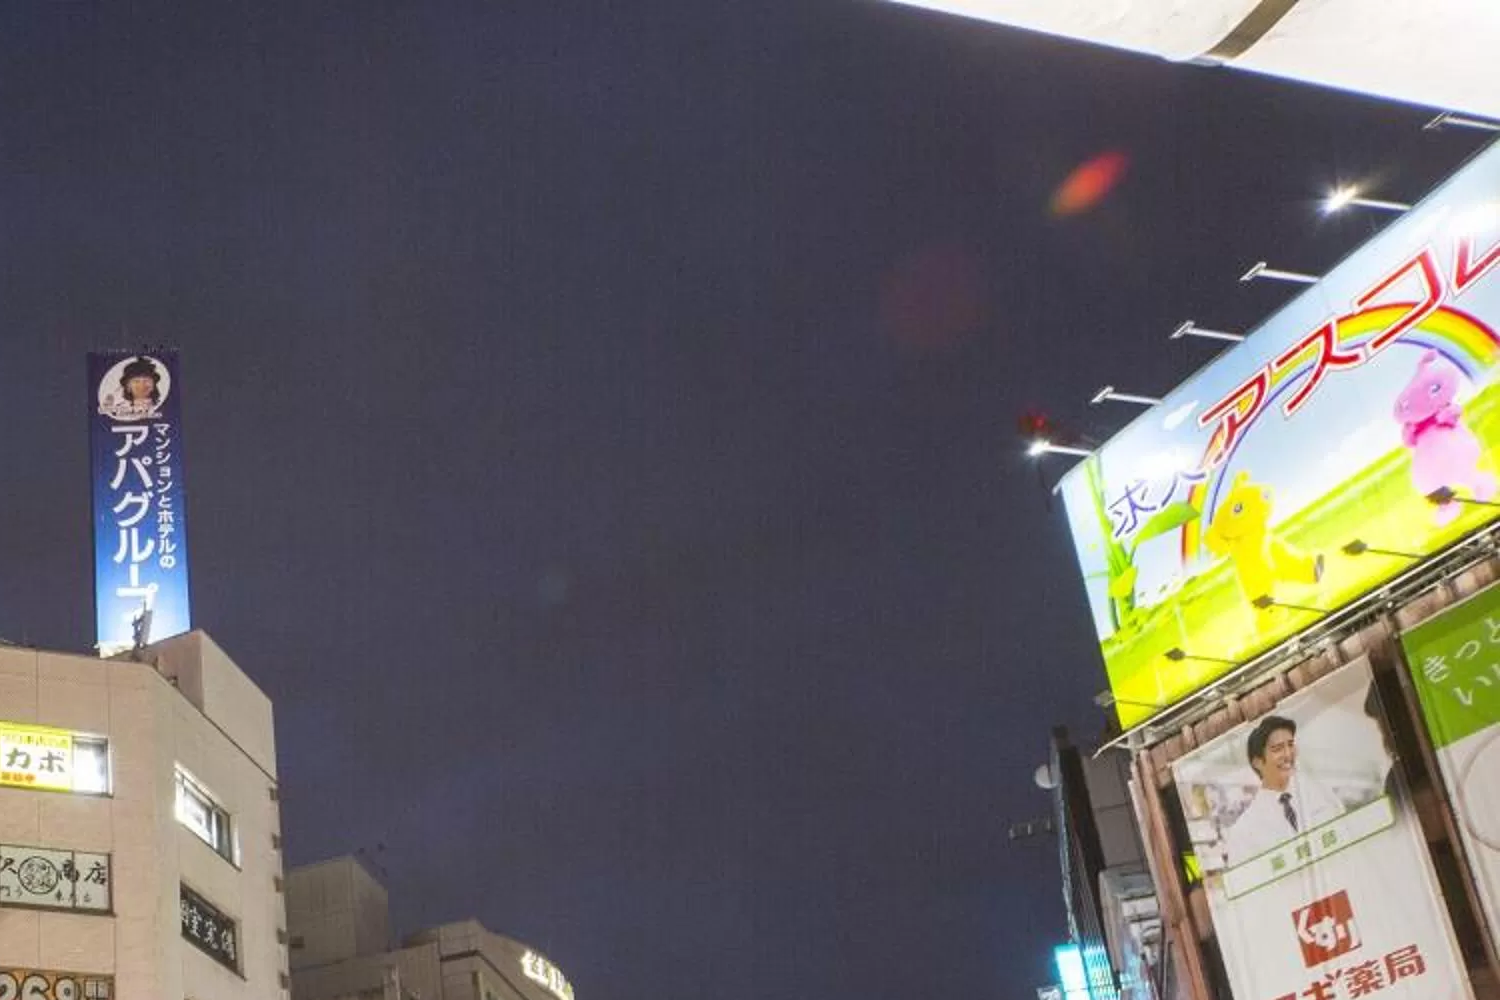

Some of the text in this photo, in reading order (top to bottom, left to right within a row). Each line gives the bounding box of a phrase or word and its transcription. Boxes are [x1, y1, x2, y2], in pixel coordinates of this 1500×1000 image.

[110, 424, 159, 623] アパグループ
[153, 423, 177, 568] マンションとホテルの
[5, 747, 66, 773] カボ
